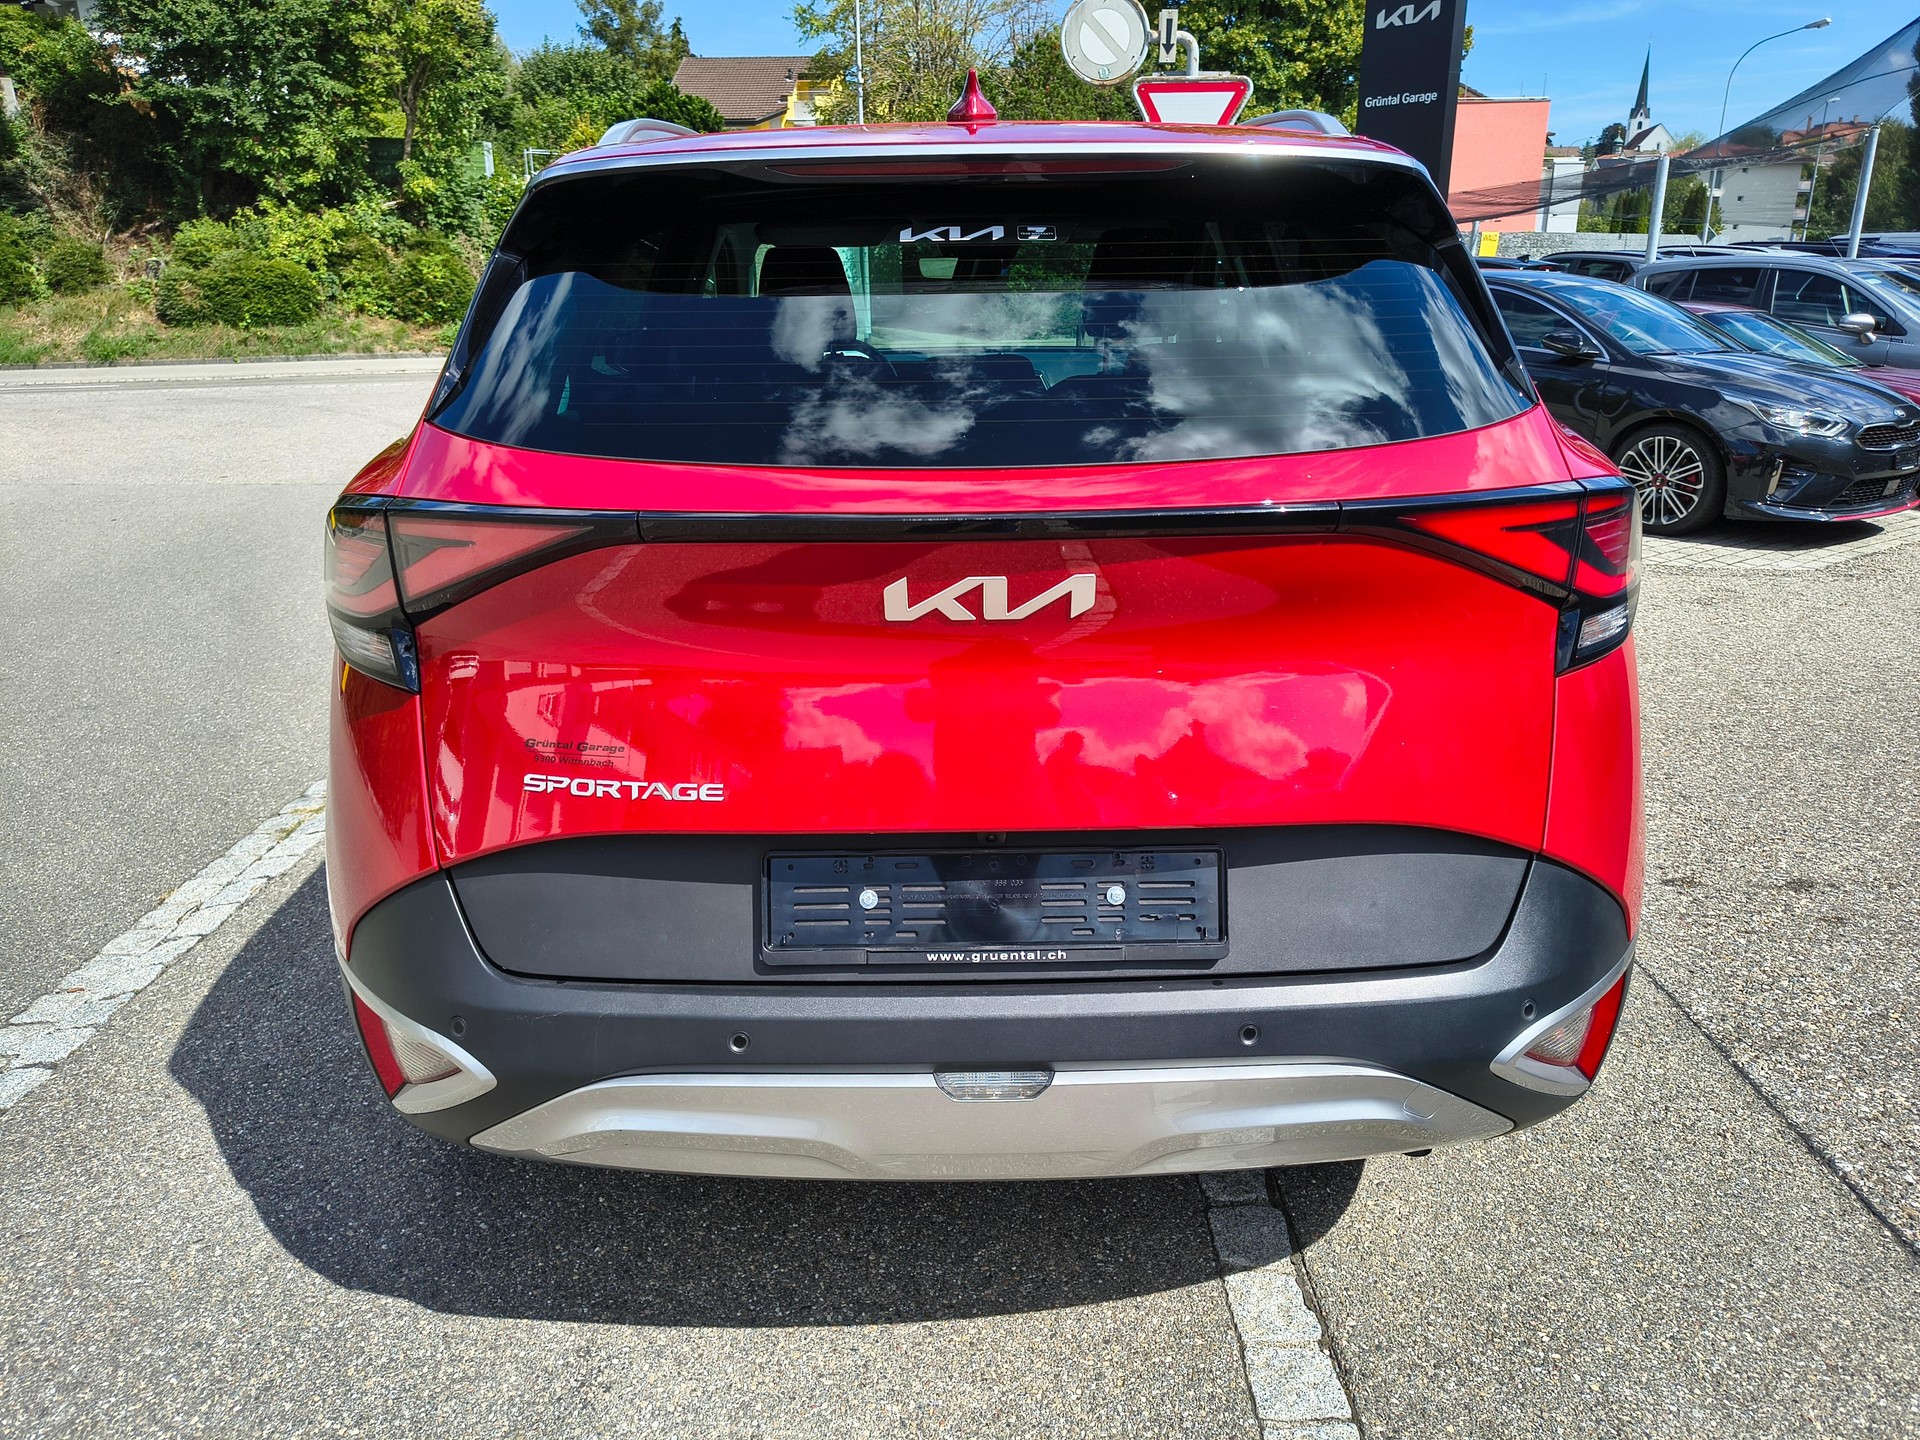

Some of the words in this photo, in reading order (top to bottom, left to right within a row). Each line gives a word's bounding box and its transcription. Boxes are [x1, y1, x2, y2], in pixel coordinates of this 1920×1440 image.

[1375, 0, 1442, 30] KIA
[1364, 93, 1400, 108] Grüntal
[1401, 91, 1438, 105] Garage
[899, 225, 1005, 243] KIA
[883, 573, 1096, 621] KIA
[524, 738, 574, 749] Grüntal
[576, 741, 626, 755] Garage
[559, 757, 615, 768] Wittenbach
[523, 773, 725, 801] SPORTAGE
[926, 949, 1068, 963] www.gruental.ch
